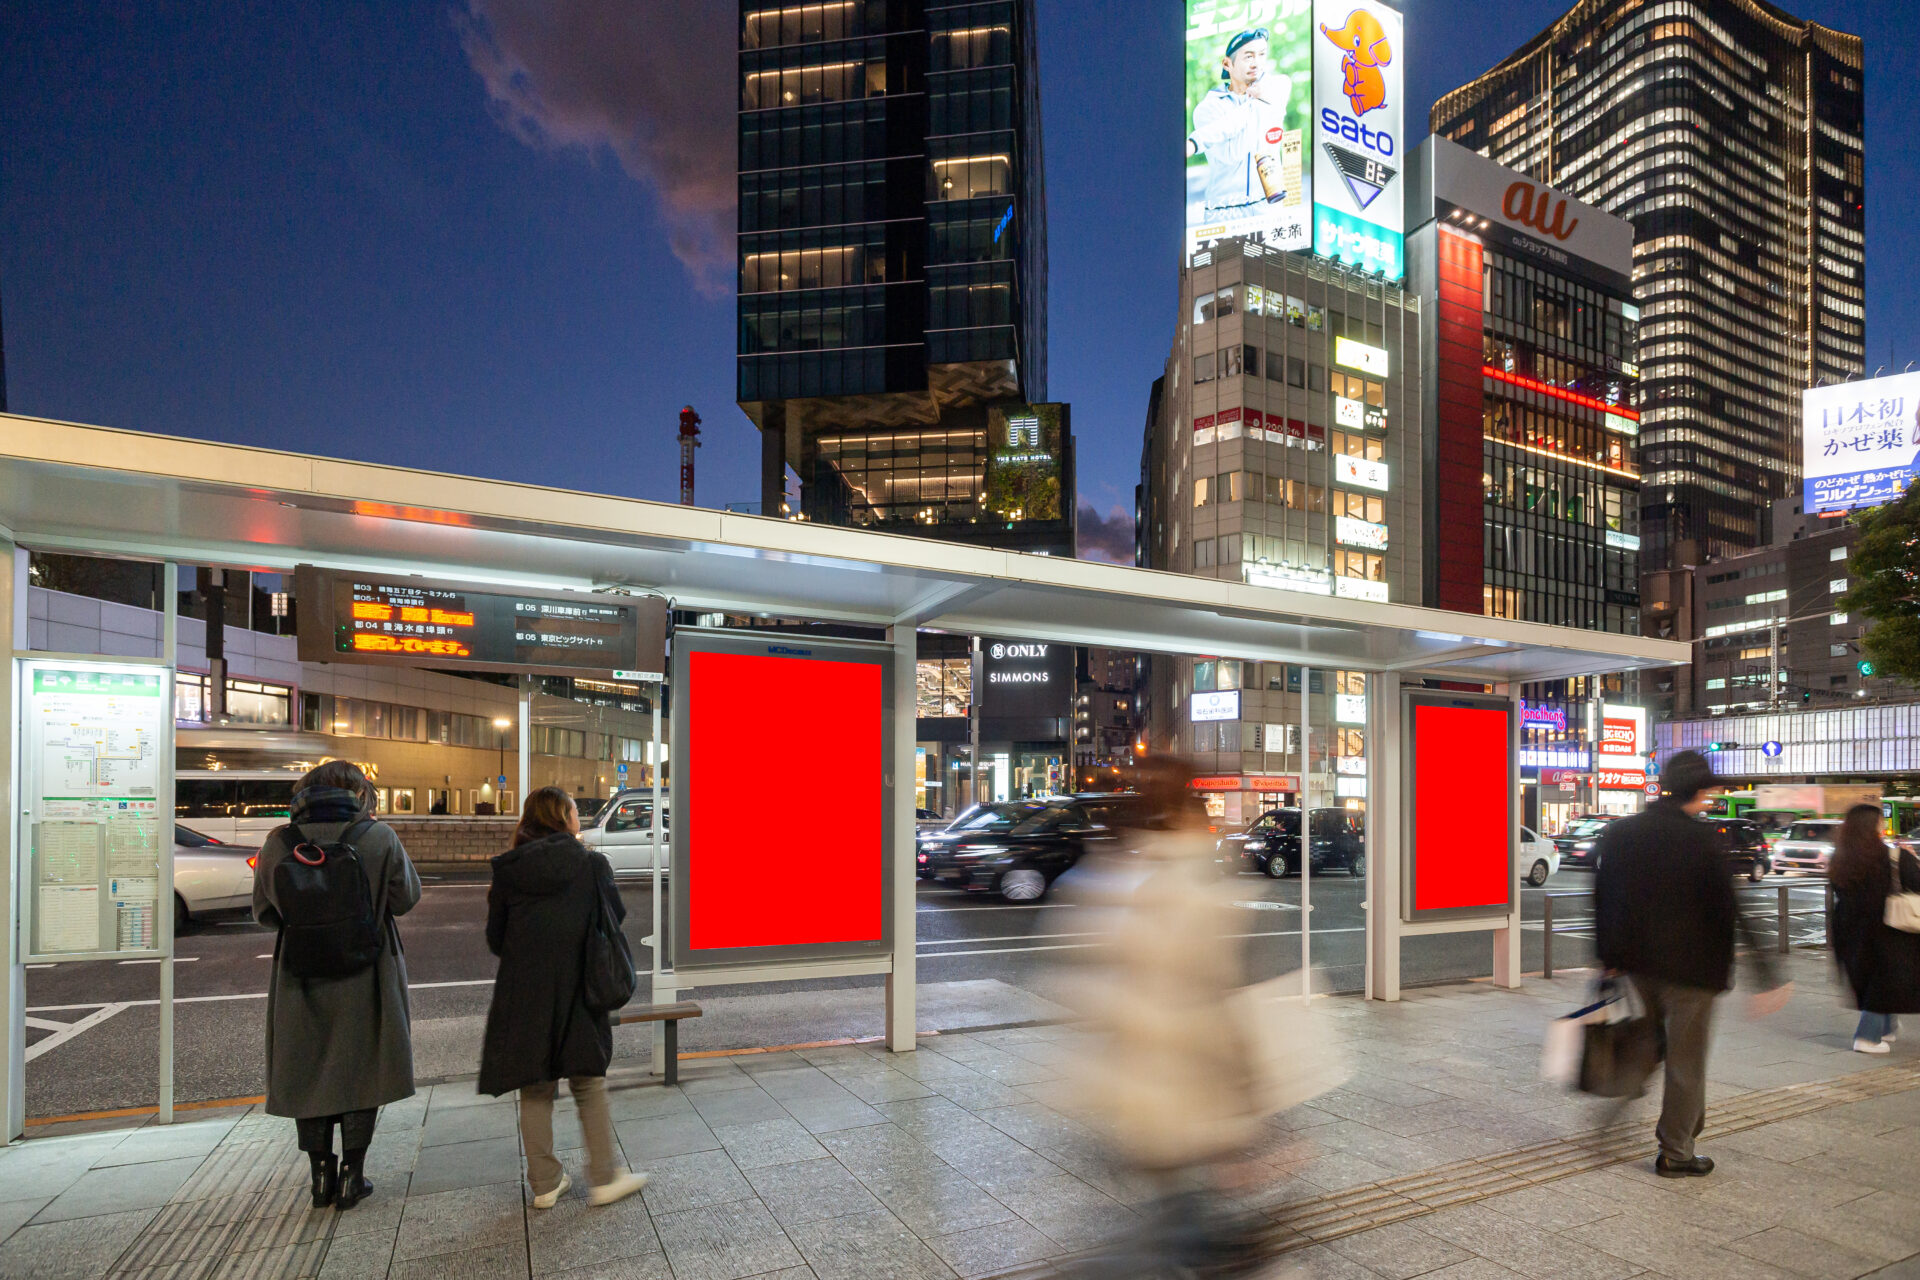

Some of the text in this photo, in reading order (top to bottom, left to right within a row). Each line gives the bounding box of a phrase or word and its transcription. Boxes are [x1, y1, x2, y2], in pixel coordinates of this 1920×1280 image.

[1322, 107, 1394, 157] sato
[1502, 181, 1579, 241] au
[1823, 397, 1904, 428] 日本初
[1824, 428, 1904, 456] かぜ薬
[1815, 474, 1861, 489] のどかぜ
[1007, 644, 1048, 657] ONLY
[990, 672, 1049, 683] SIMMONS
